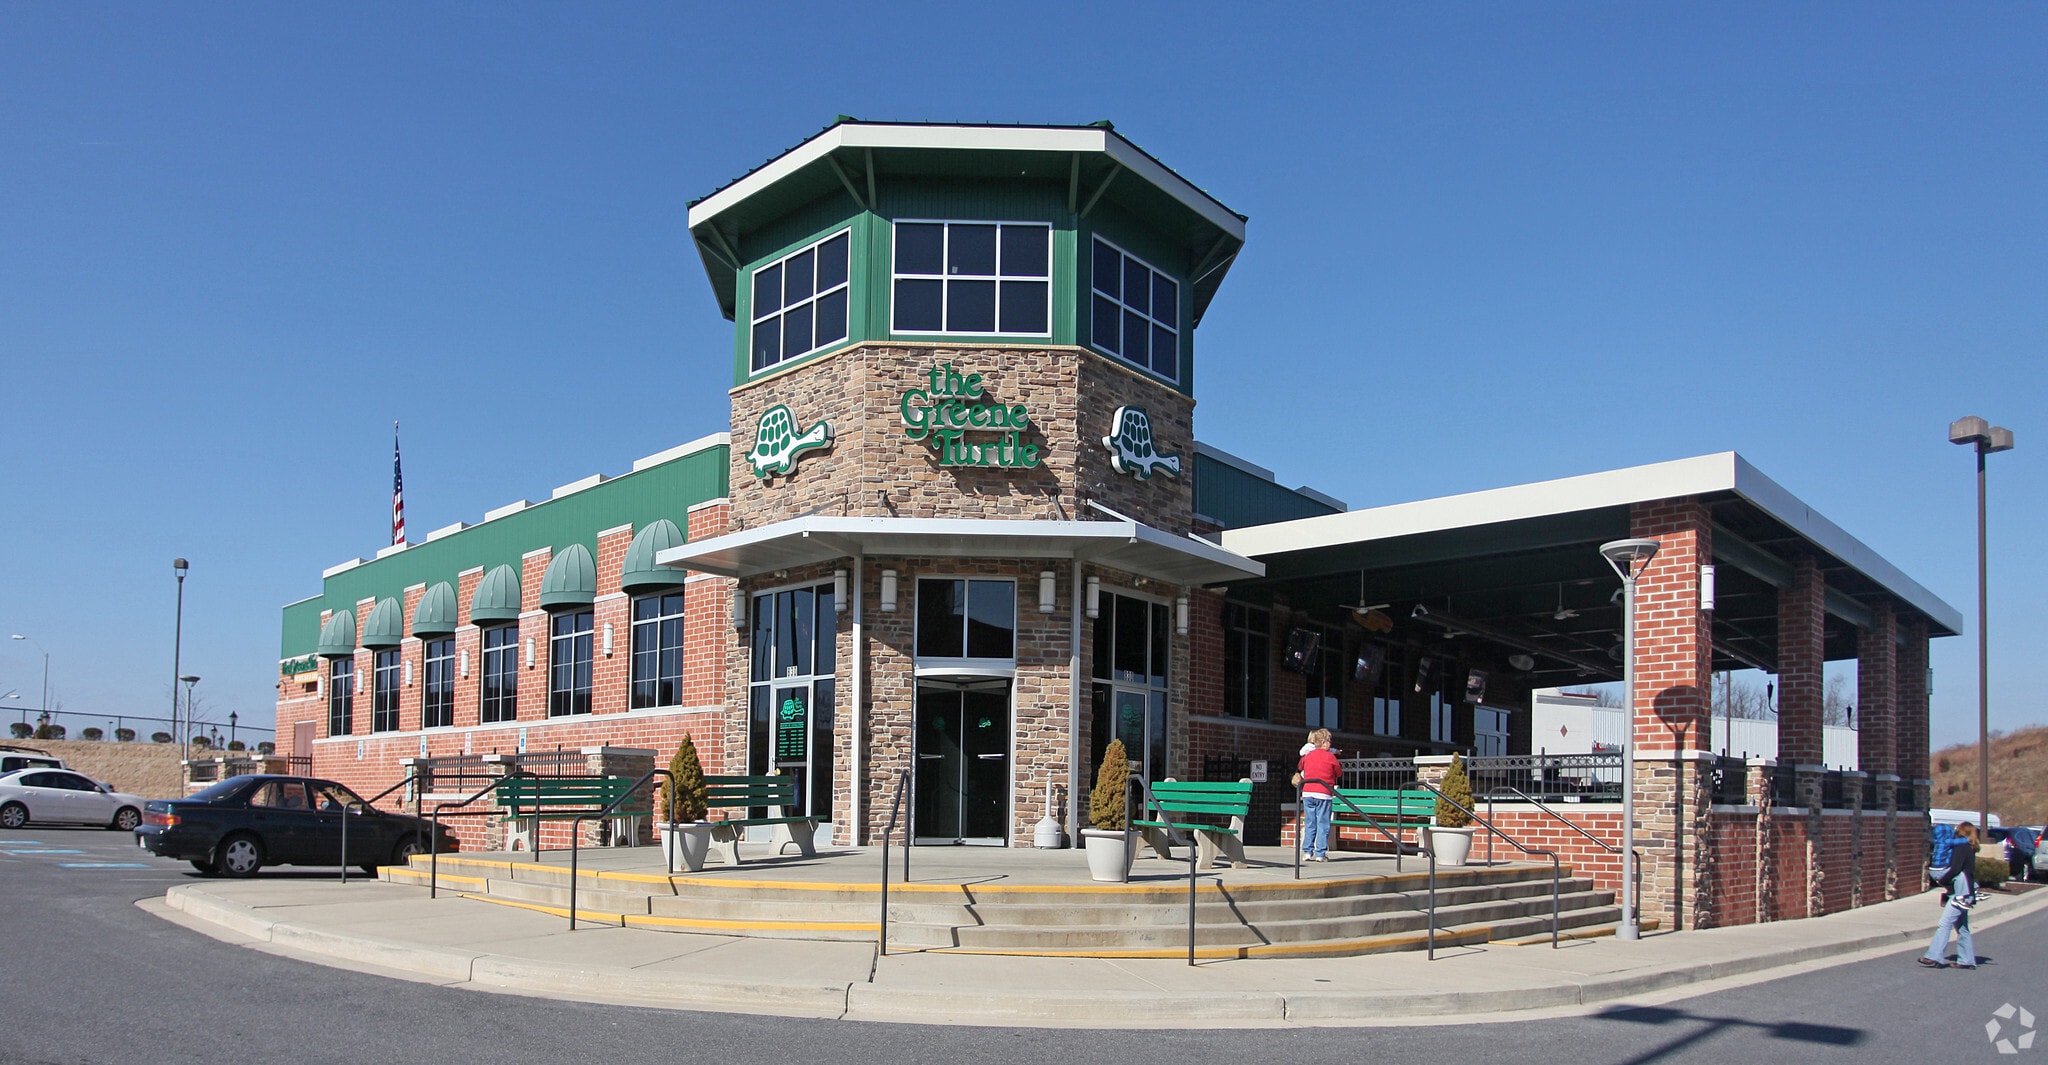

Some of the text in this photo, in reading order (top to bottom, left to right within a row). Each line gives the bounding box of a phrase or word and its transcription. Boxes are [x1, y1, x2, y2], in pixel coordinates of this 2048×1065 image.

[927, 363, 984, 396] the
[901, 389, 1030, 439] Greene
[932, 429, 1040, 467] Turtle
